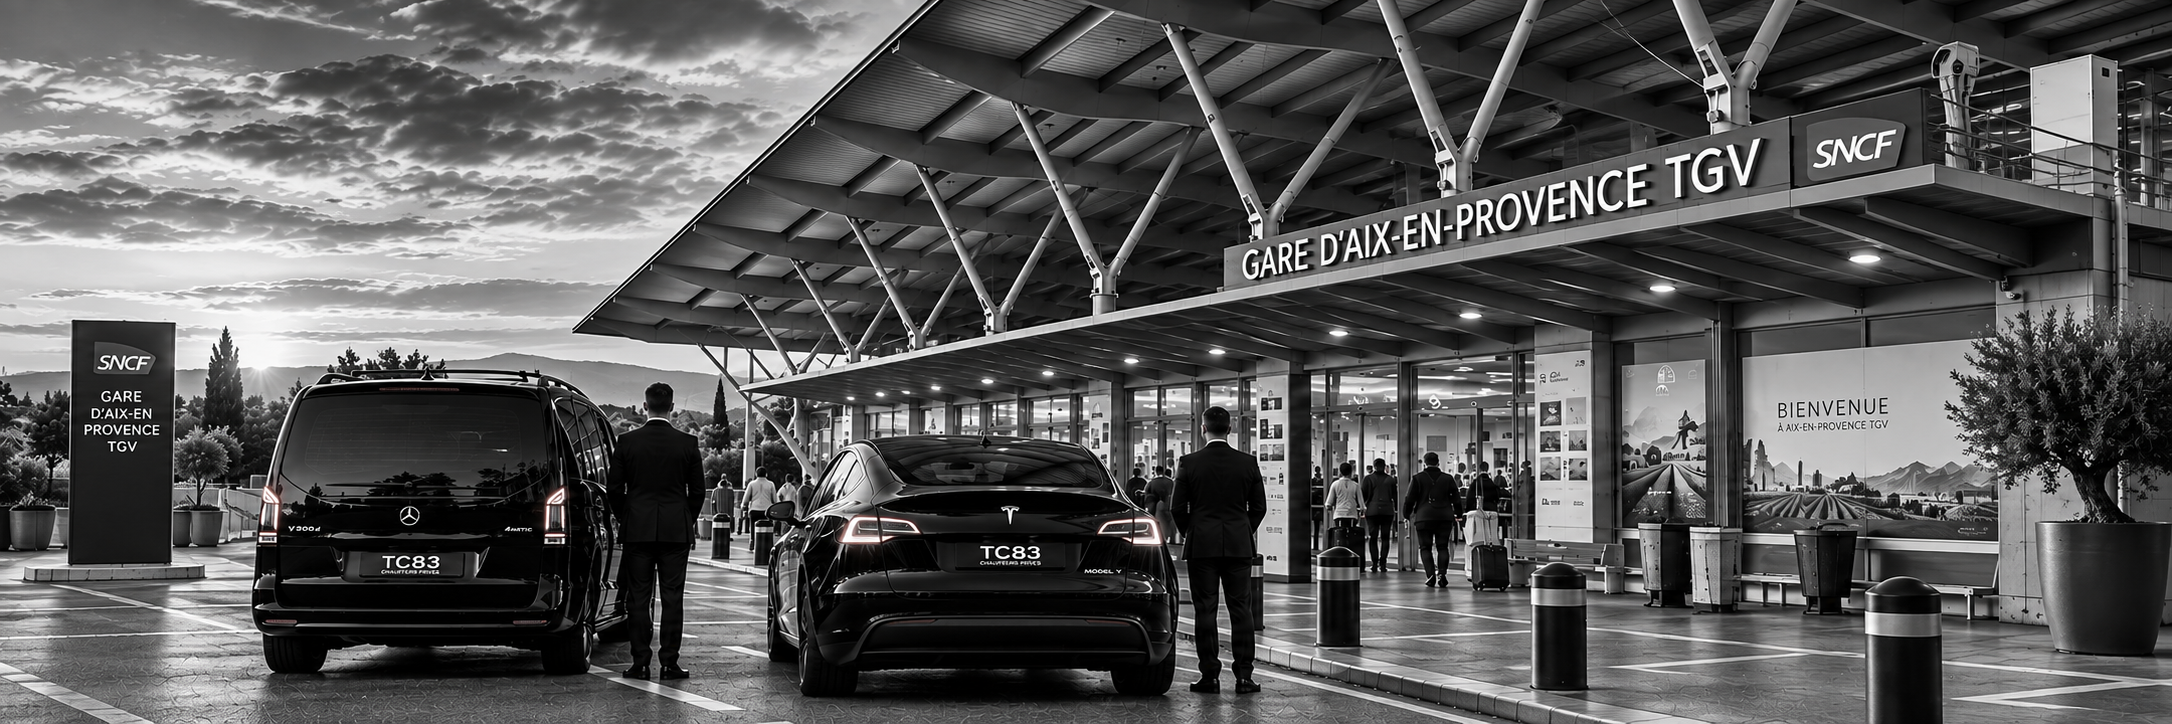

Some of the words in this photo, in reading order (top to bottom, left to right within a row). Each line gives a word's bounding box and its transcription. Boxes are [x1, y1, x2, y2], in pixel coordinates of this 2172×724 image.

[1813, 129, 1897, 169] SNCF
[1242, 237, 1314, 281] GARE
[1320, 163, 1648, 266] D'AIX-EN-PROVENCE
[1665, 137, 1765, 200] TGV
[97, 354, 151, 371] SNCF
[100, 390, 142, 403] GARE
[1778, 397, 1889, 418] BIENVENUE
[83, 424, 160, 436] PROVENCE
[1785, 419, 1867, 432] AIX-EN-PROVENCE
[1869, 419, 1889, 430] TGV
[107, 440, 138, 453] TGV
[979, 545, 1041, 560] TC83
[381, 555, 440, 569] TC83
